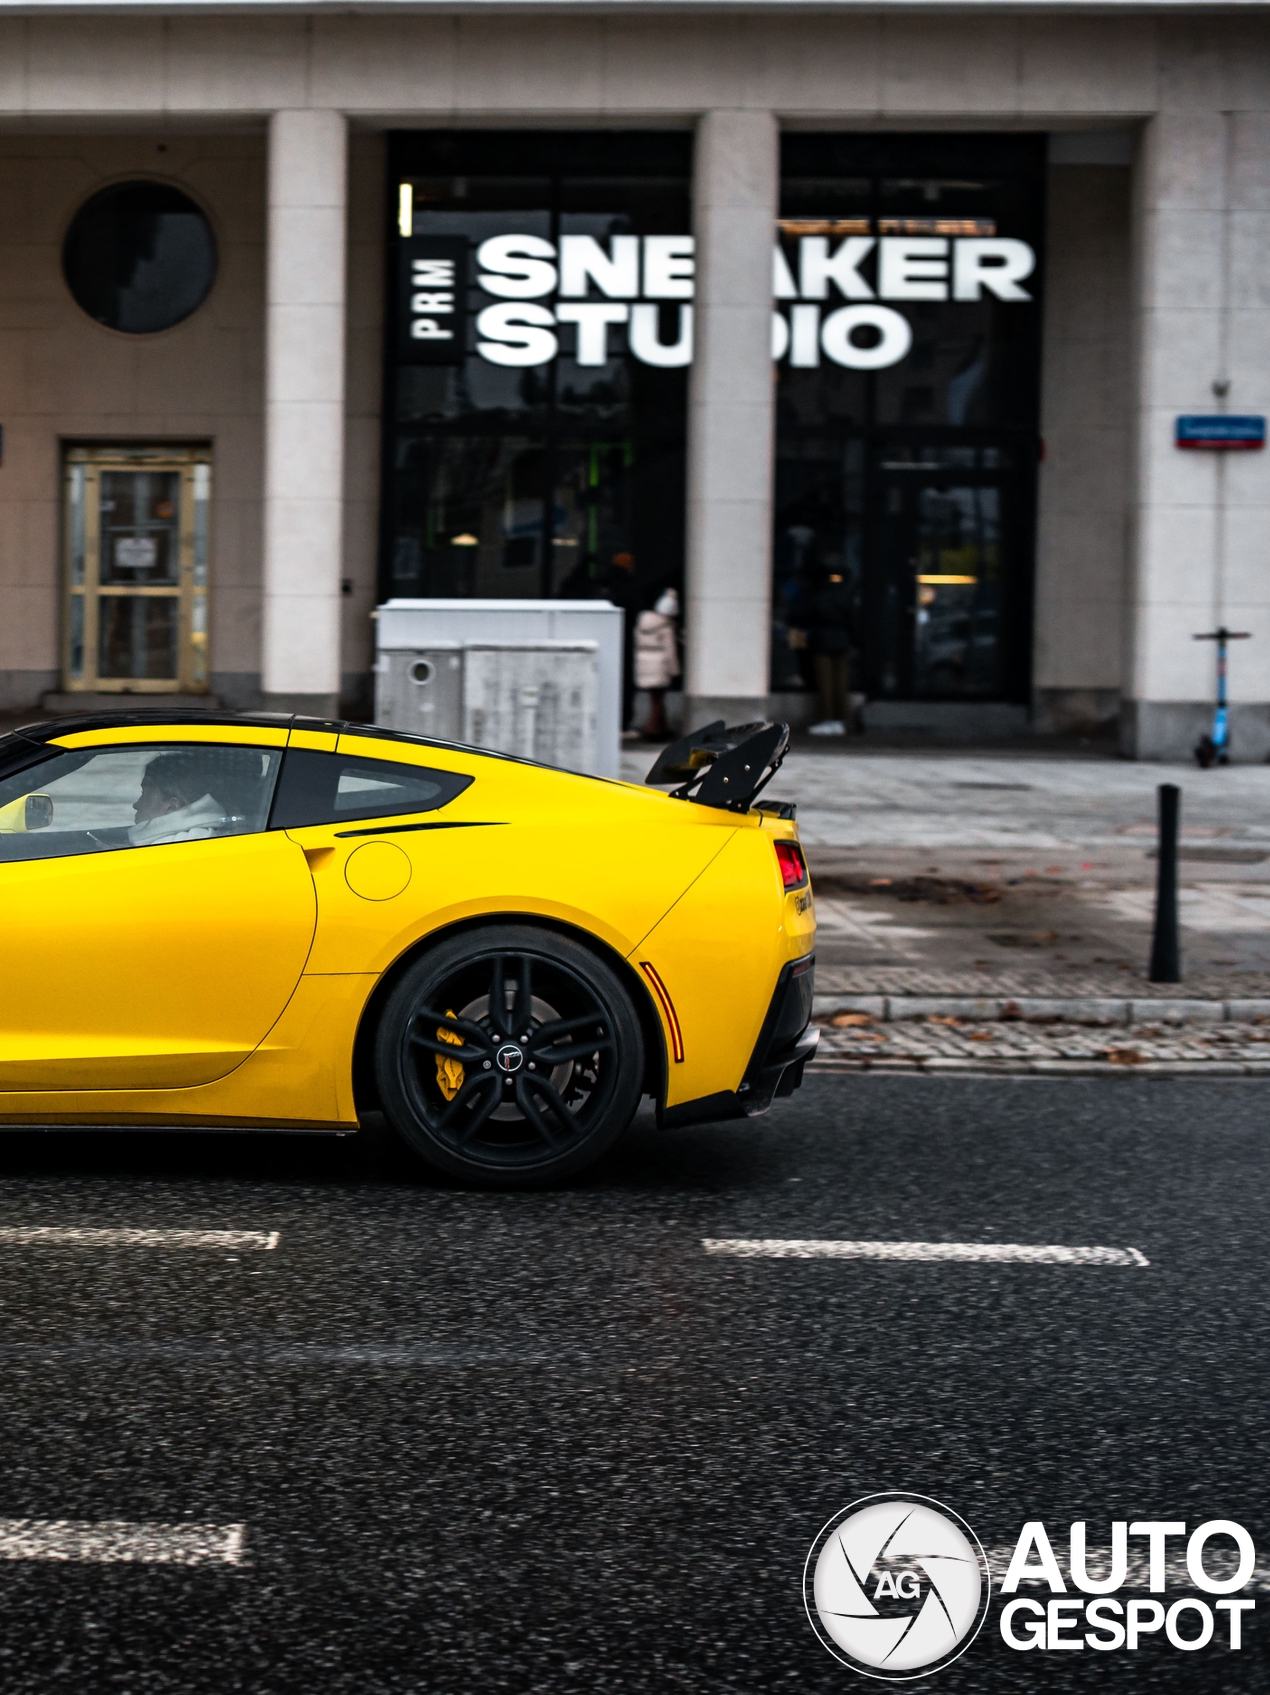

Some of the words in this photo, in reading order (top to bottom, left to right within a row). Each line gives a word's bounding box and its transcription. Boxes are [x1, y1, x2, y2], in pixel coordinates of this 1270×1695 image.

[411, 258, 455, 340] PRM
[477, 234, 1034, 300] SNEKER
[476, 301, 911, 369] STUIO
